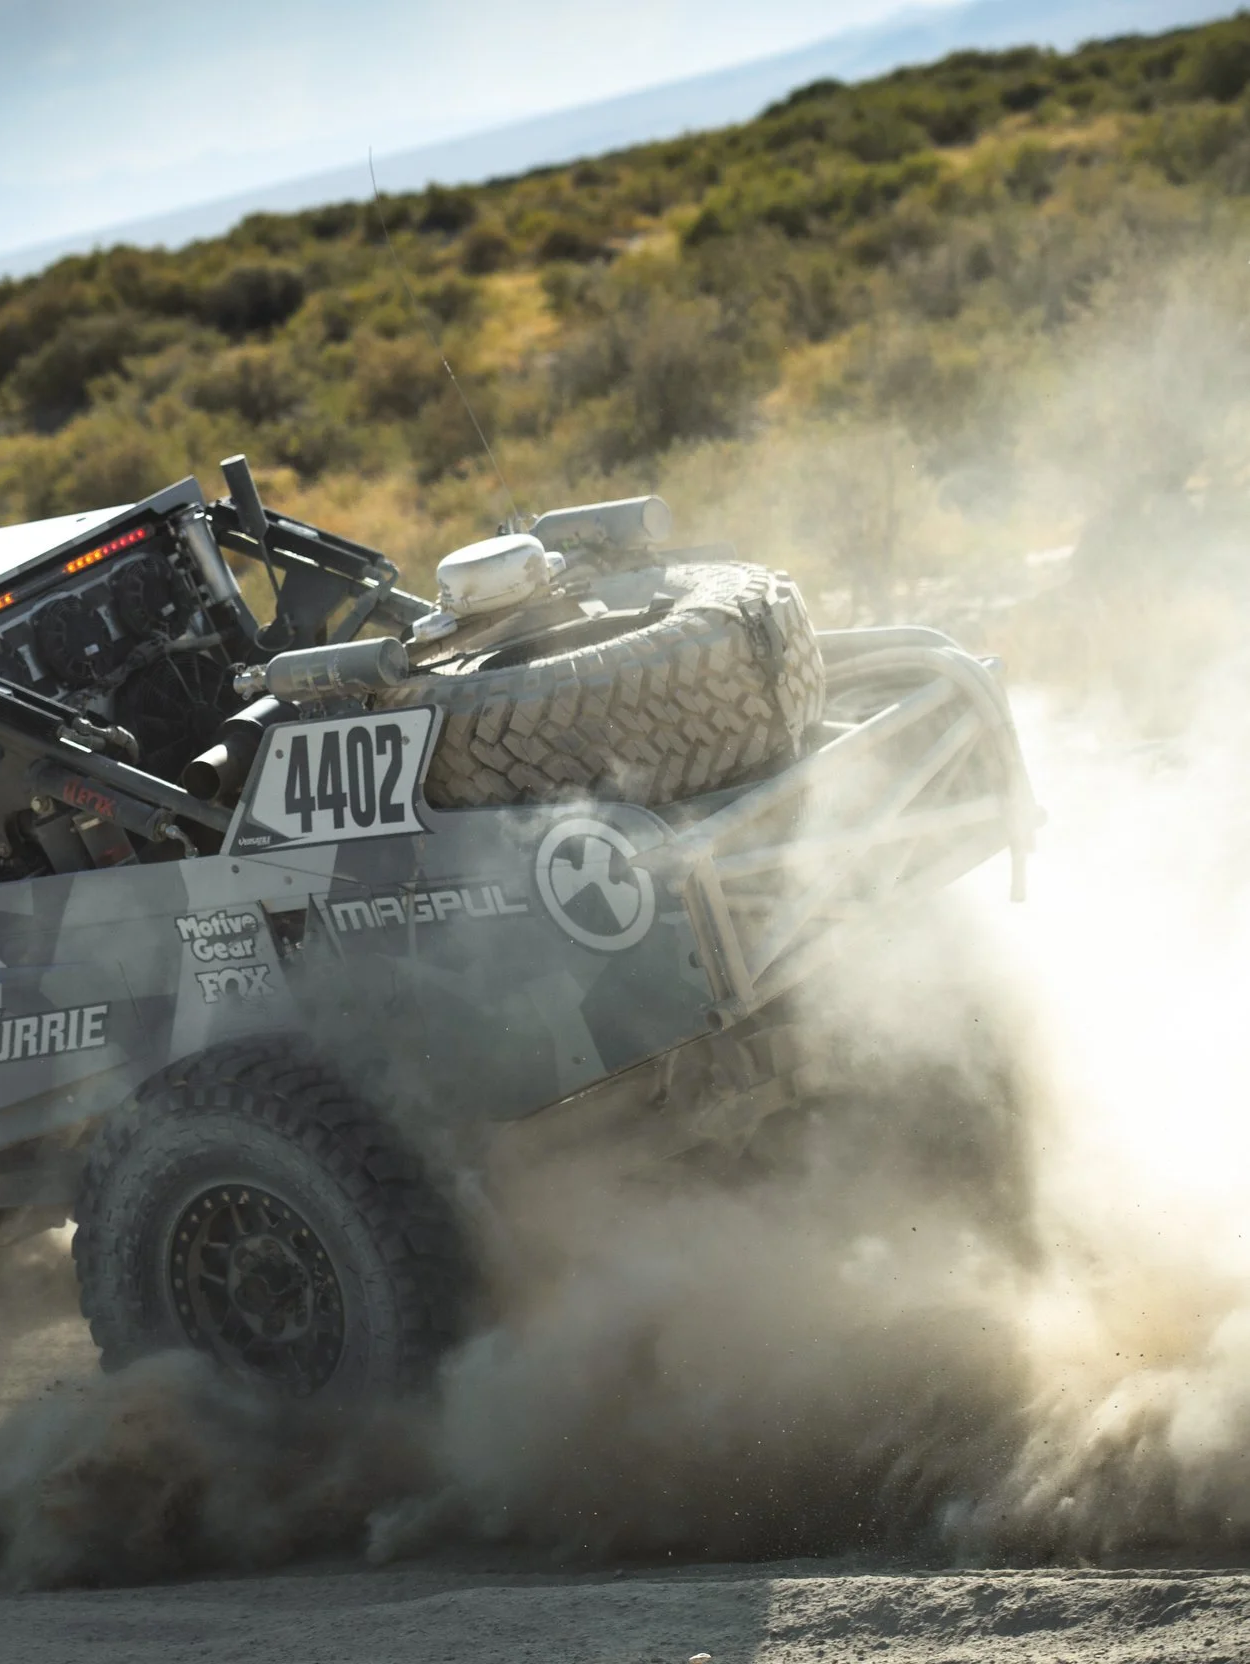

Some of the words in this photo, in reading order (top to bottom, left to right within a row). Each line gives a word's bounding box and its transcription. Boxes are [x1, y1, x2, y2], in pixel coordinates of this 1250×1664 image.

[285, 724, 405, 833] 4402
[175, 912, 257, 940] Motive
[330, 885, 529, 932] MAGPUL
[192, 938, 254, 961] Gear
[196, 966, 274, 1004] FOX
